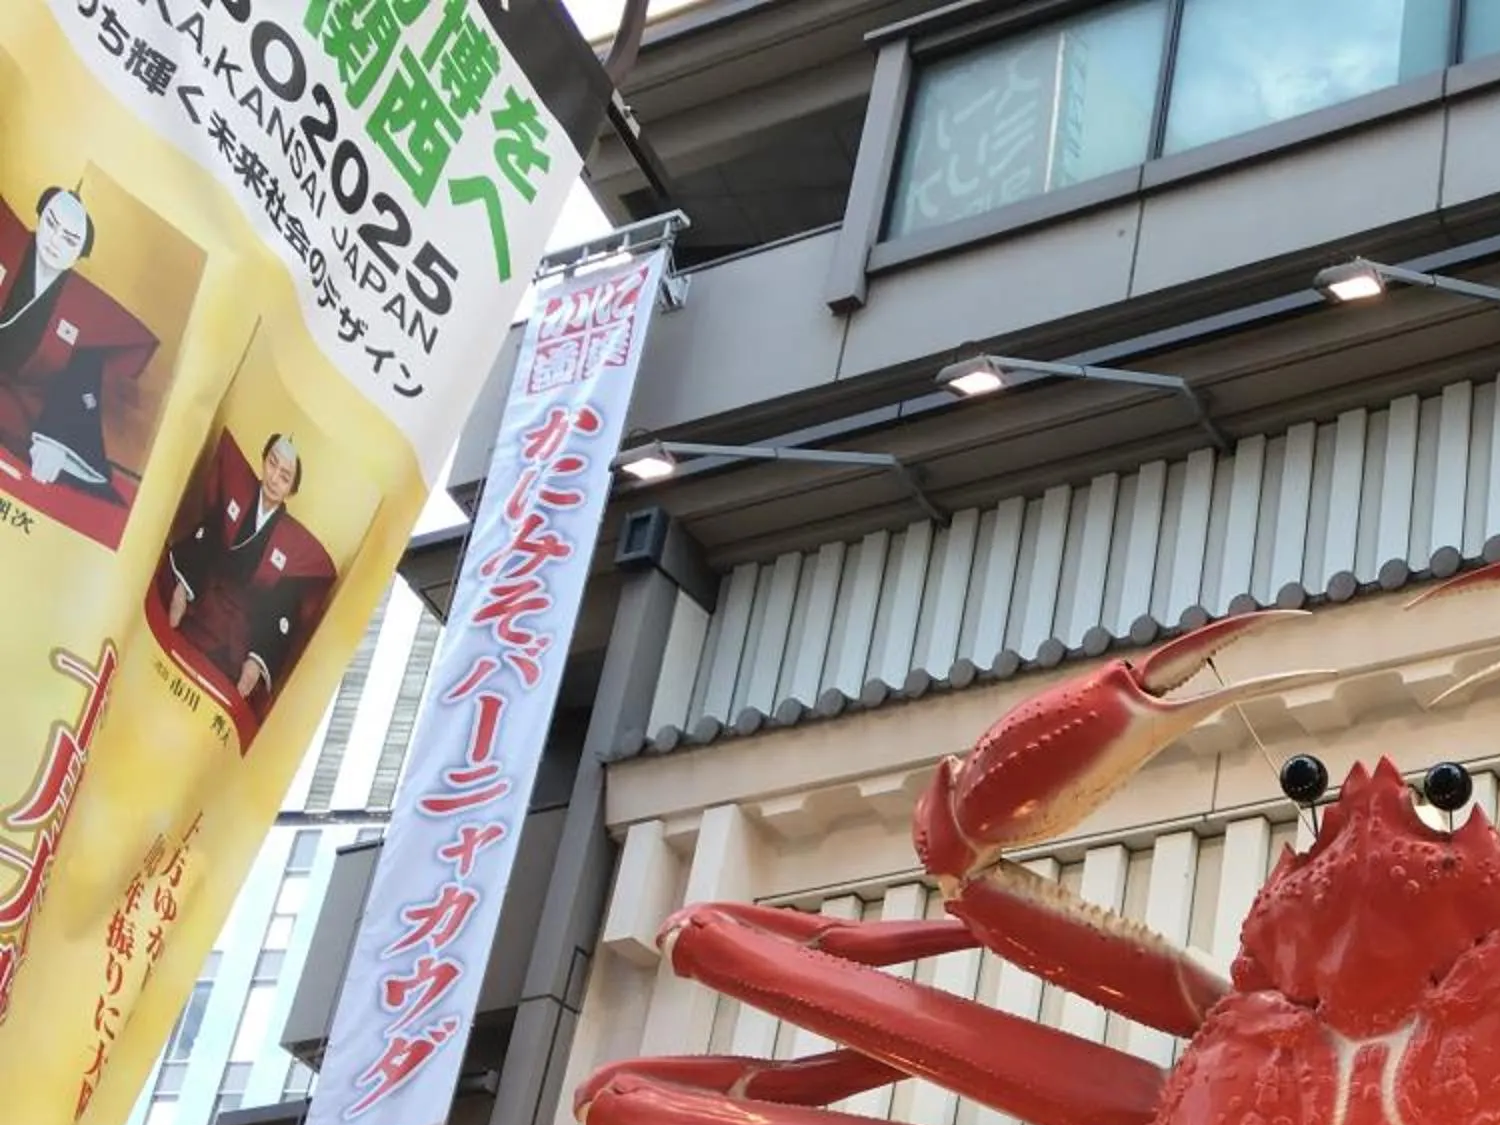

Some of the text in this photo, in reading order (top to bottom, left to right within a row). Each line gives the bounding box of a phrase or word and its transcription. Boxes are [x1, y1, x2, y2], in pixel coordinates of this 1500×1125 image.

[331, 226, 439, 354] JAPAN
[348, 405, 601, 1120] かにみそバーニャカウダ
